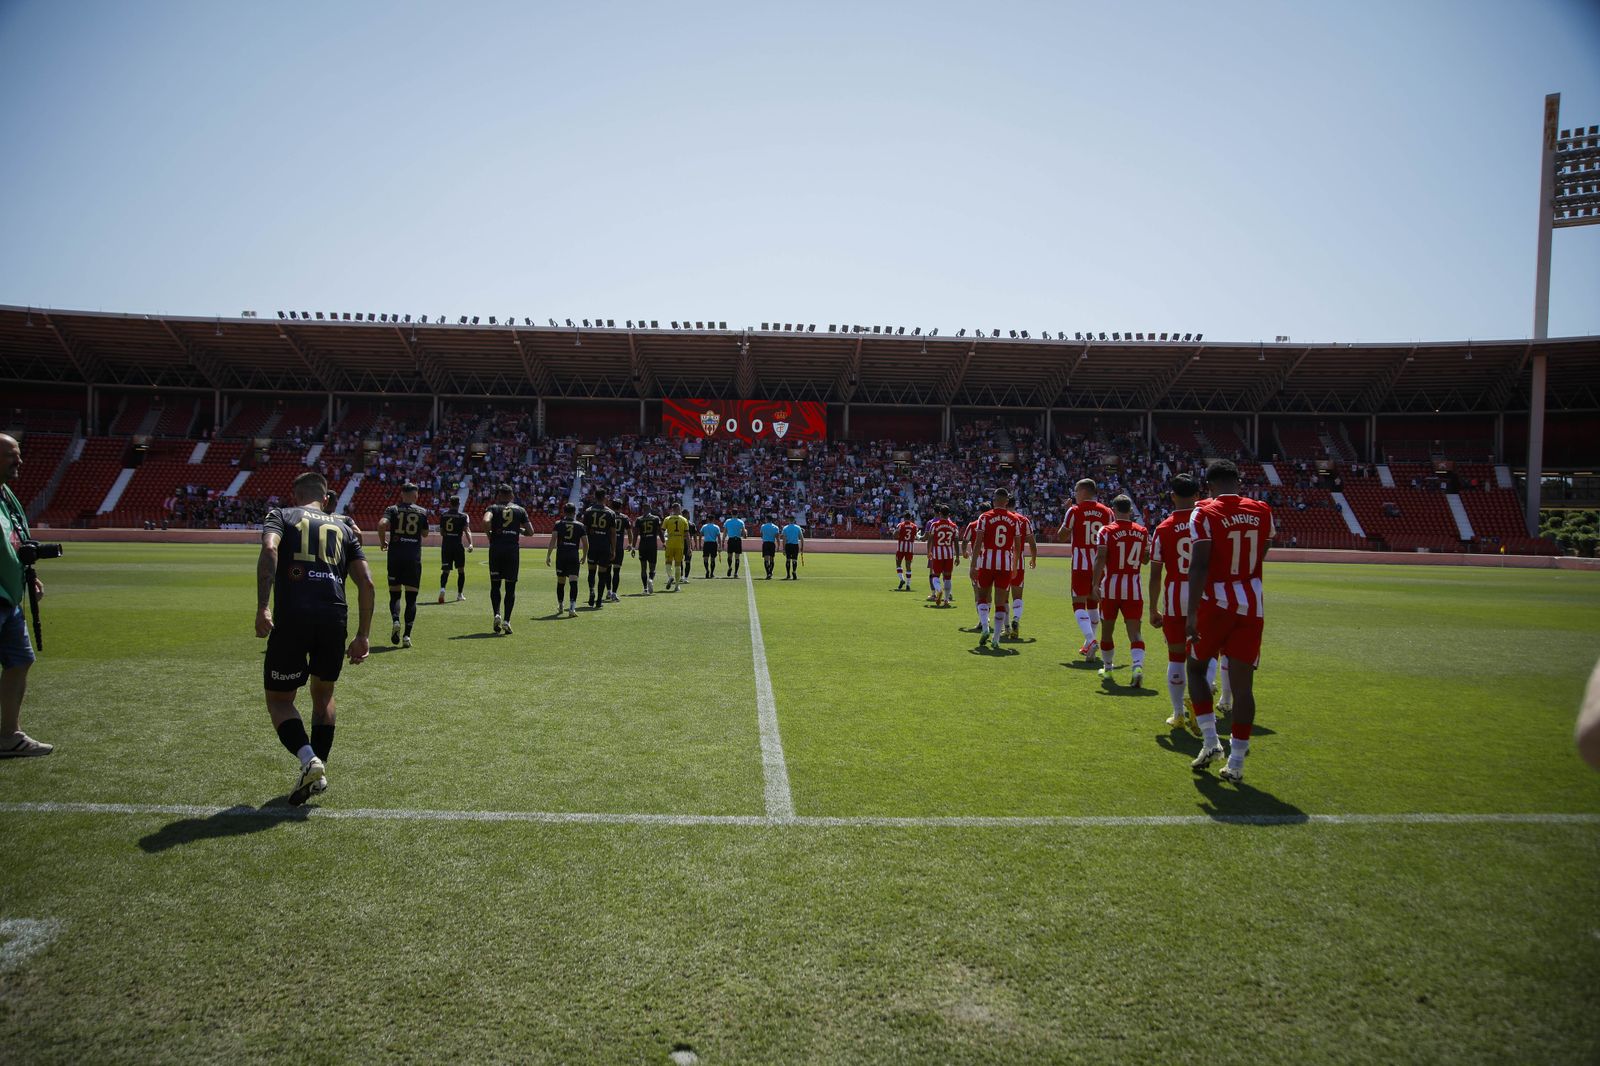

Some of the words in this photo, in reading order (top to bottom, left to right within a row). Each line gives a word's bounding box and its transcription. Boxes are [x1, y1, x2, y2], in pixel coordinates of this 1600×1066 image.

[726, 418, 738, 433] 0
[751, 418, 763, 433] 0
[304, 510, 335, 522] ADRI
[394, 511, 419, 535] 18
[446, 517, 454, 532] 6
[502, 508, 514, 528] 9
[591, 511, 607, 529] 16
[1221, 513, 1260, 528] H.NEVES
[565, 523, 575, 540] 3
[643, 520, 654, 534] 15
[674, 520, 680, 532] 1
[904, 528, 912, 540] 3
[1082, 520, 1103, 545] 18
[293, 517, 343, 566] 10
[937, 531, 953, 546] 23
[995, 525, 1008, 547] 6
[1116, 541, 1142, 570] 14
[1176, 537, 1193, 574] 8
[1227, 529, 1259, 575] 11
